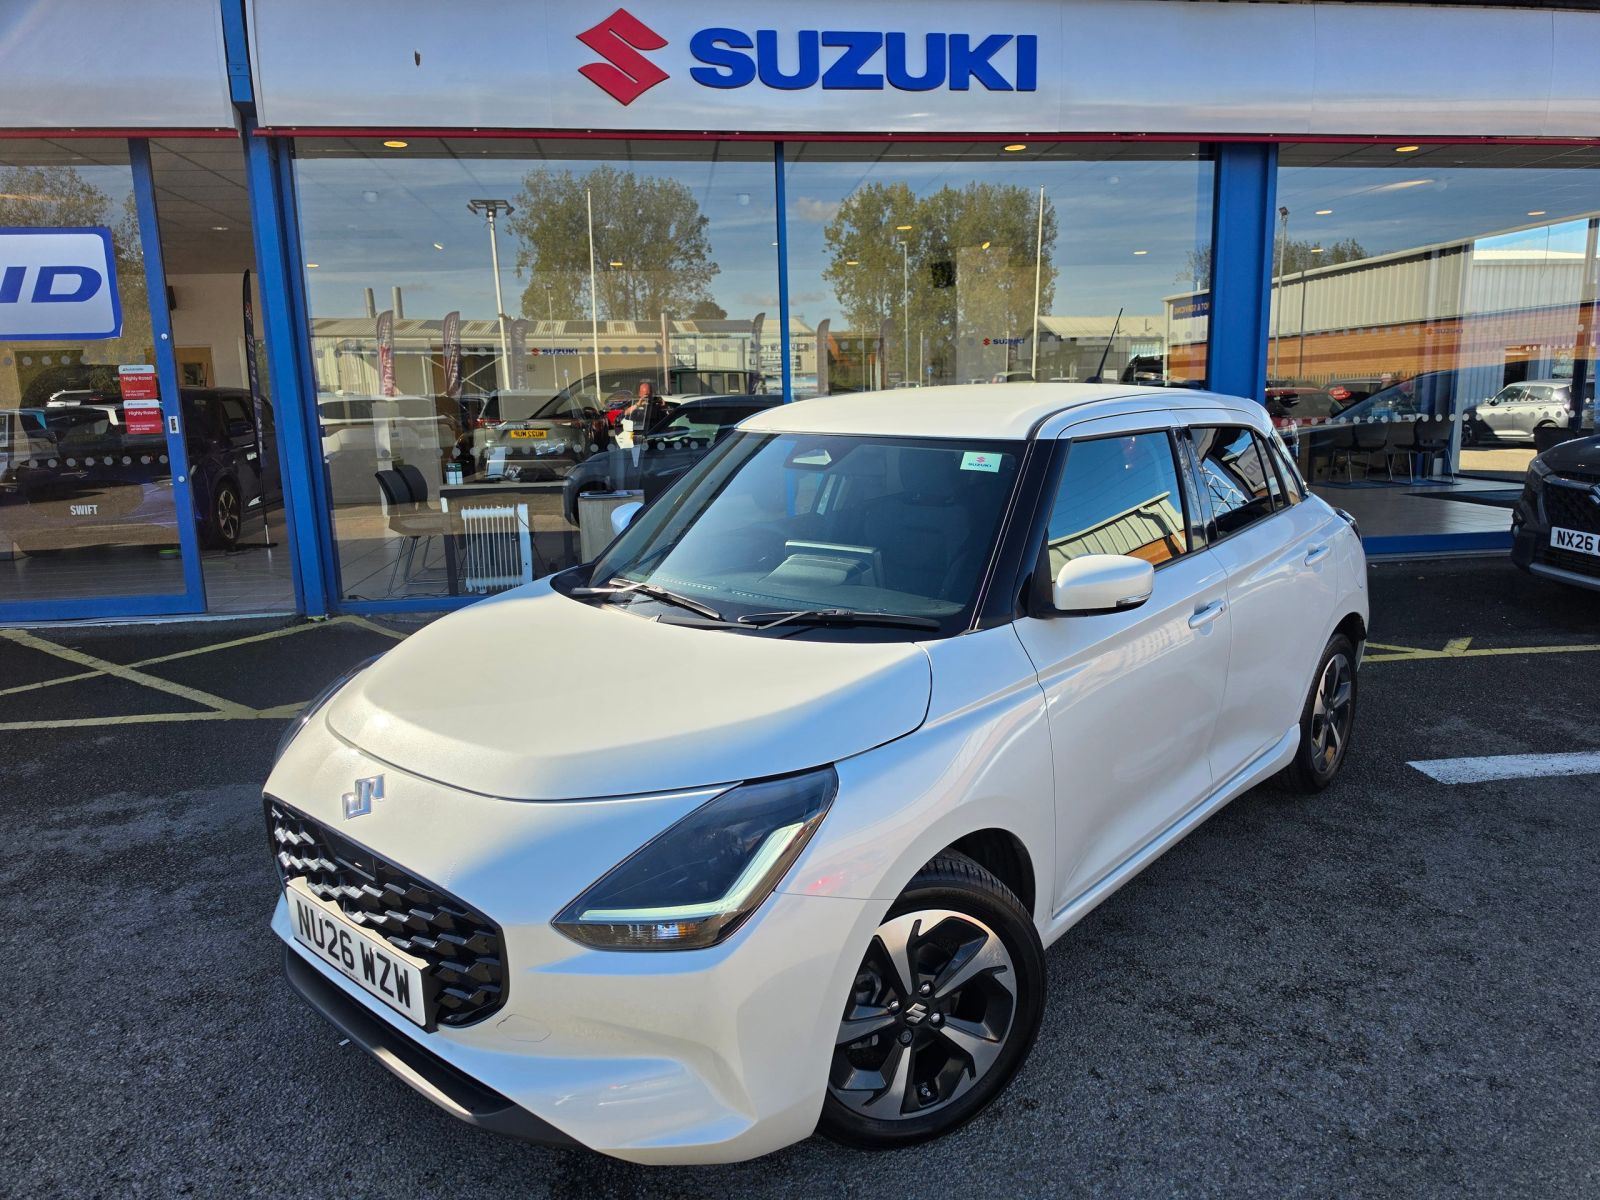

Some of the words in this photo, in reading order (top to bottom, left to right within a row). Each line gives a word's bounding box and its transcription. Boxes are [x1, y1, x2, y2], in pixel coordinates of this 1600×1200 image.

[689, 27, 1037, 92] SUZUKI
[0, 266, 103, 303] ID
[70, 504, 98, 516] SWIFT
[1556, 530, 1594, 551] NX26
[296, 900, 355, 971] NU26
[359, 941, 411, 1009] WZW
